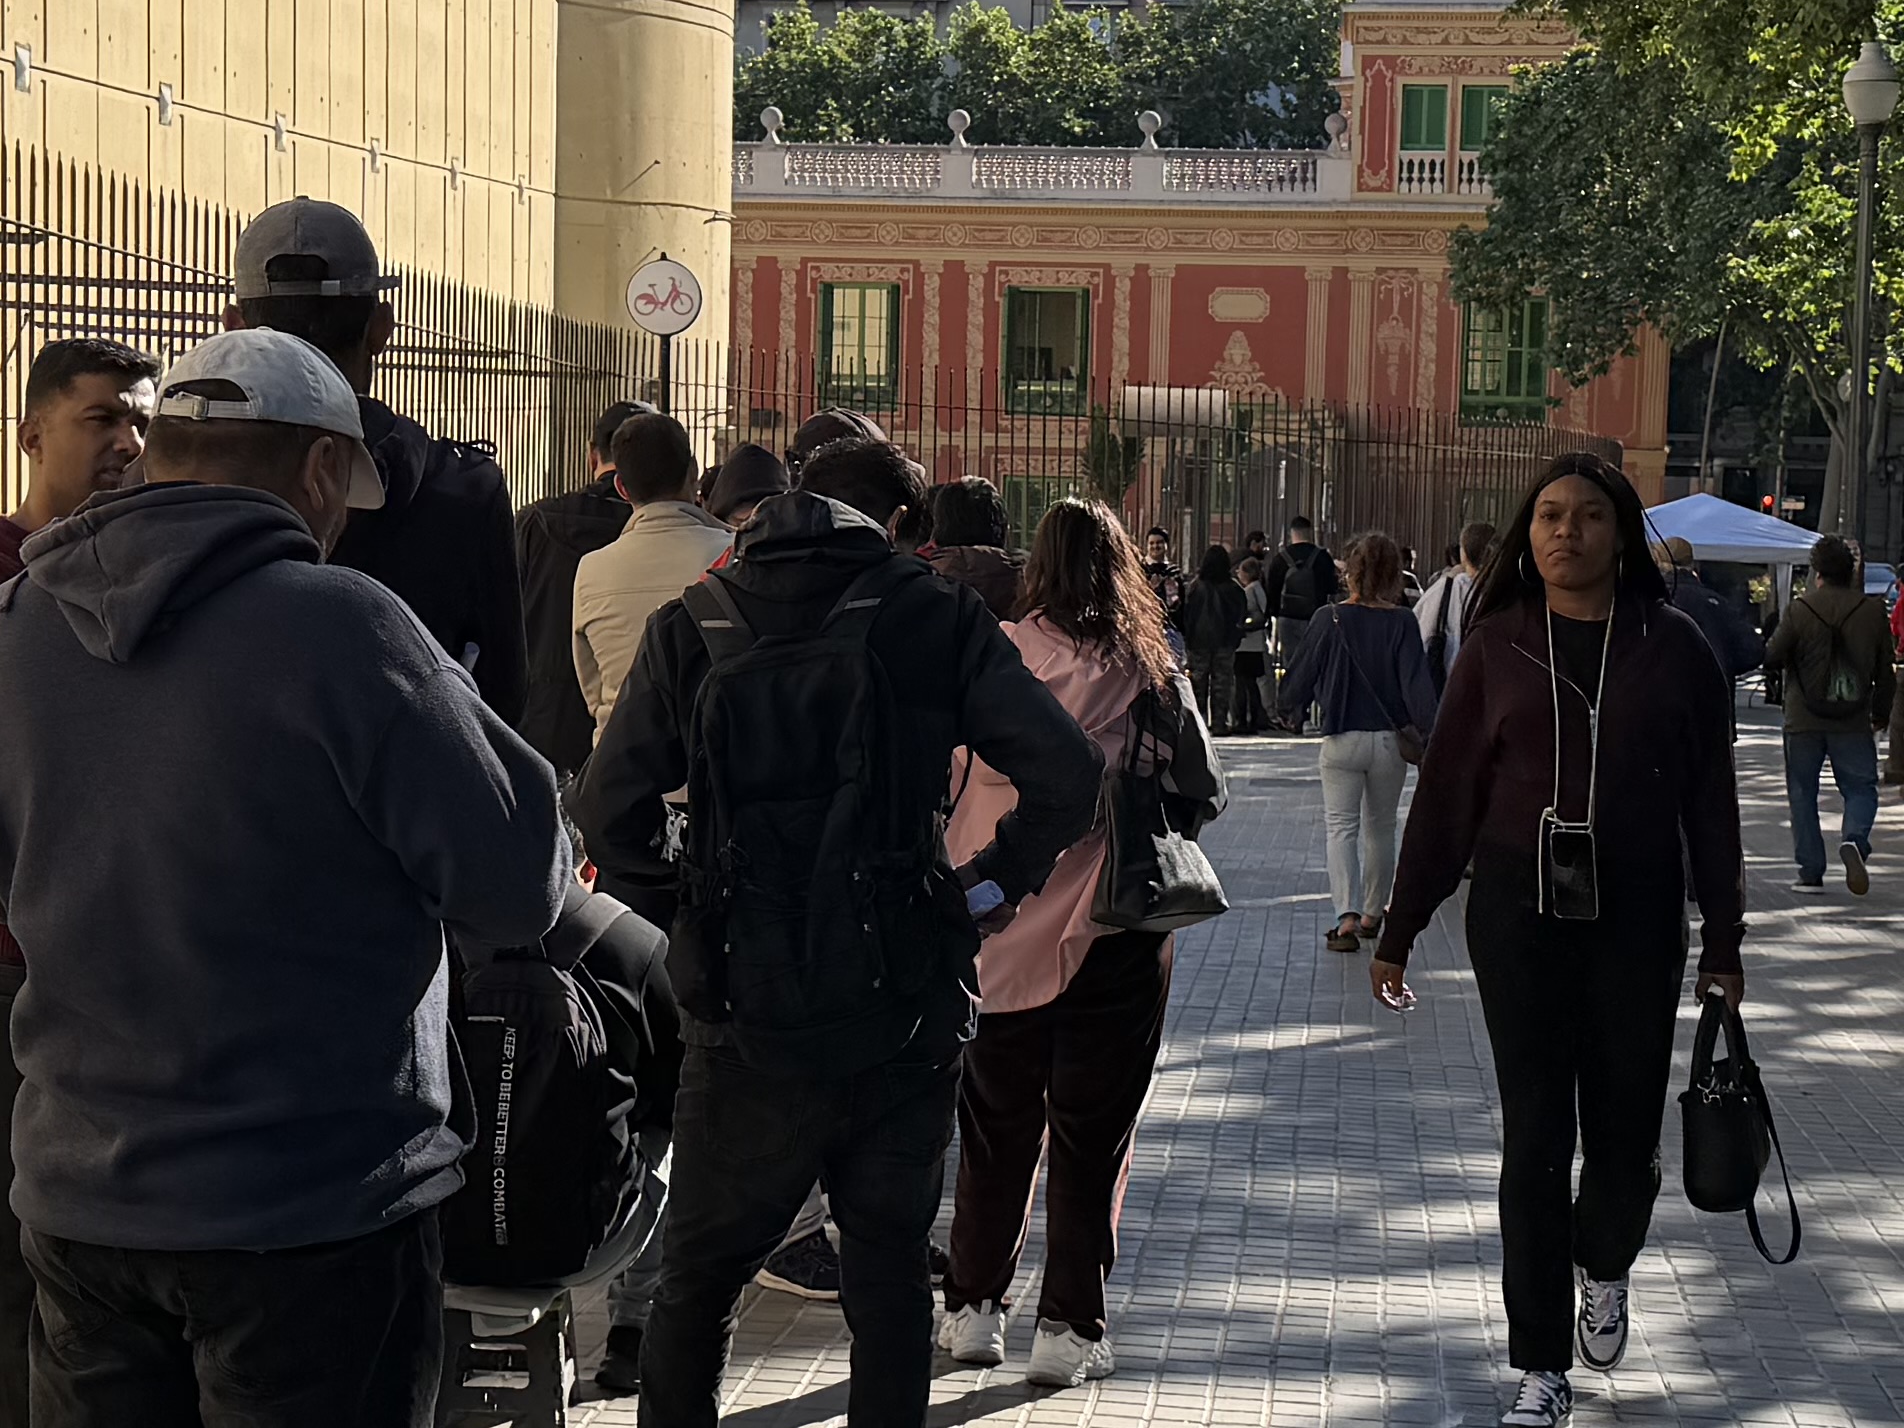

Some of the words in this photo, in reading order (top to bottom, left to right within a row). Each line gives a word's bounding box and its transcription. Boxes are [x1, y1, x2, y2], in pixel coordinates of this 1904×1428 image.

[501, 1062, 514, 1080] TO
[498, 1082, 512, 1101] BE
[493, 1102, 510, 1155] BETTER
